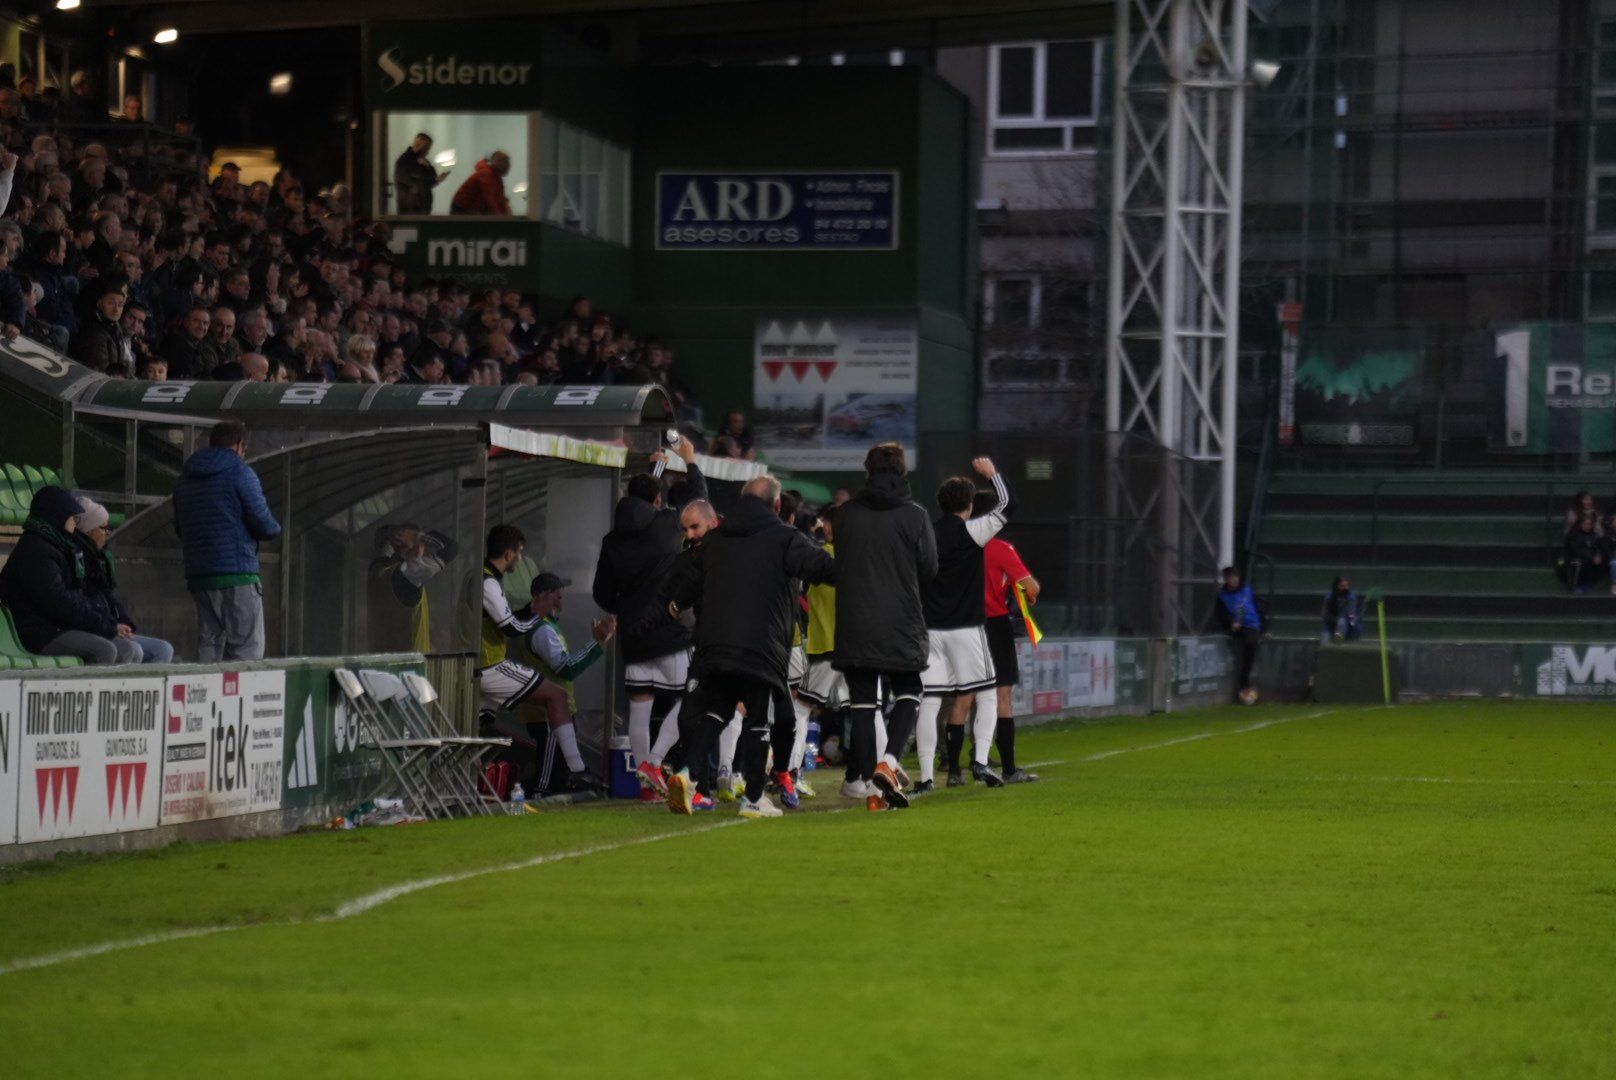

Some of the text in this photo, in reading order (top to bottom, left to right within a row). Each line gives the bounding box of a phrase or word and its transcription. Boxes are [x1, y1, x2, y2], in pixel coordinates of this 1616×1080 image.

[408, 55, 533, 86] sidenor
[671, 179, 794, 222] ARD
[427, 239, 528, 267] mirai
[663, 226, 801, 243] asesores
[1546, 364, 1616, 396] Re
[27, 691, 93, 735] miramar
[98, 690, 160, 733] miramar
[209, 696, 249, 793] itek
